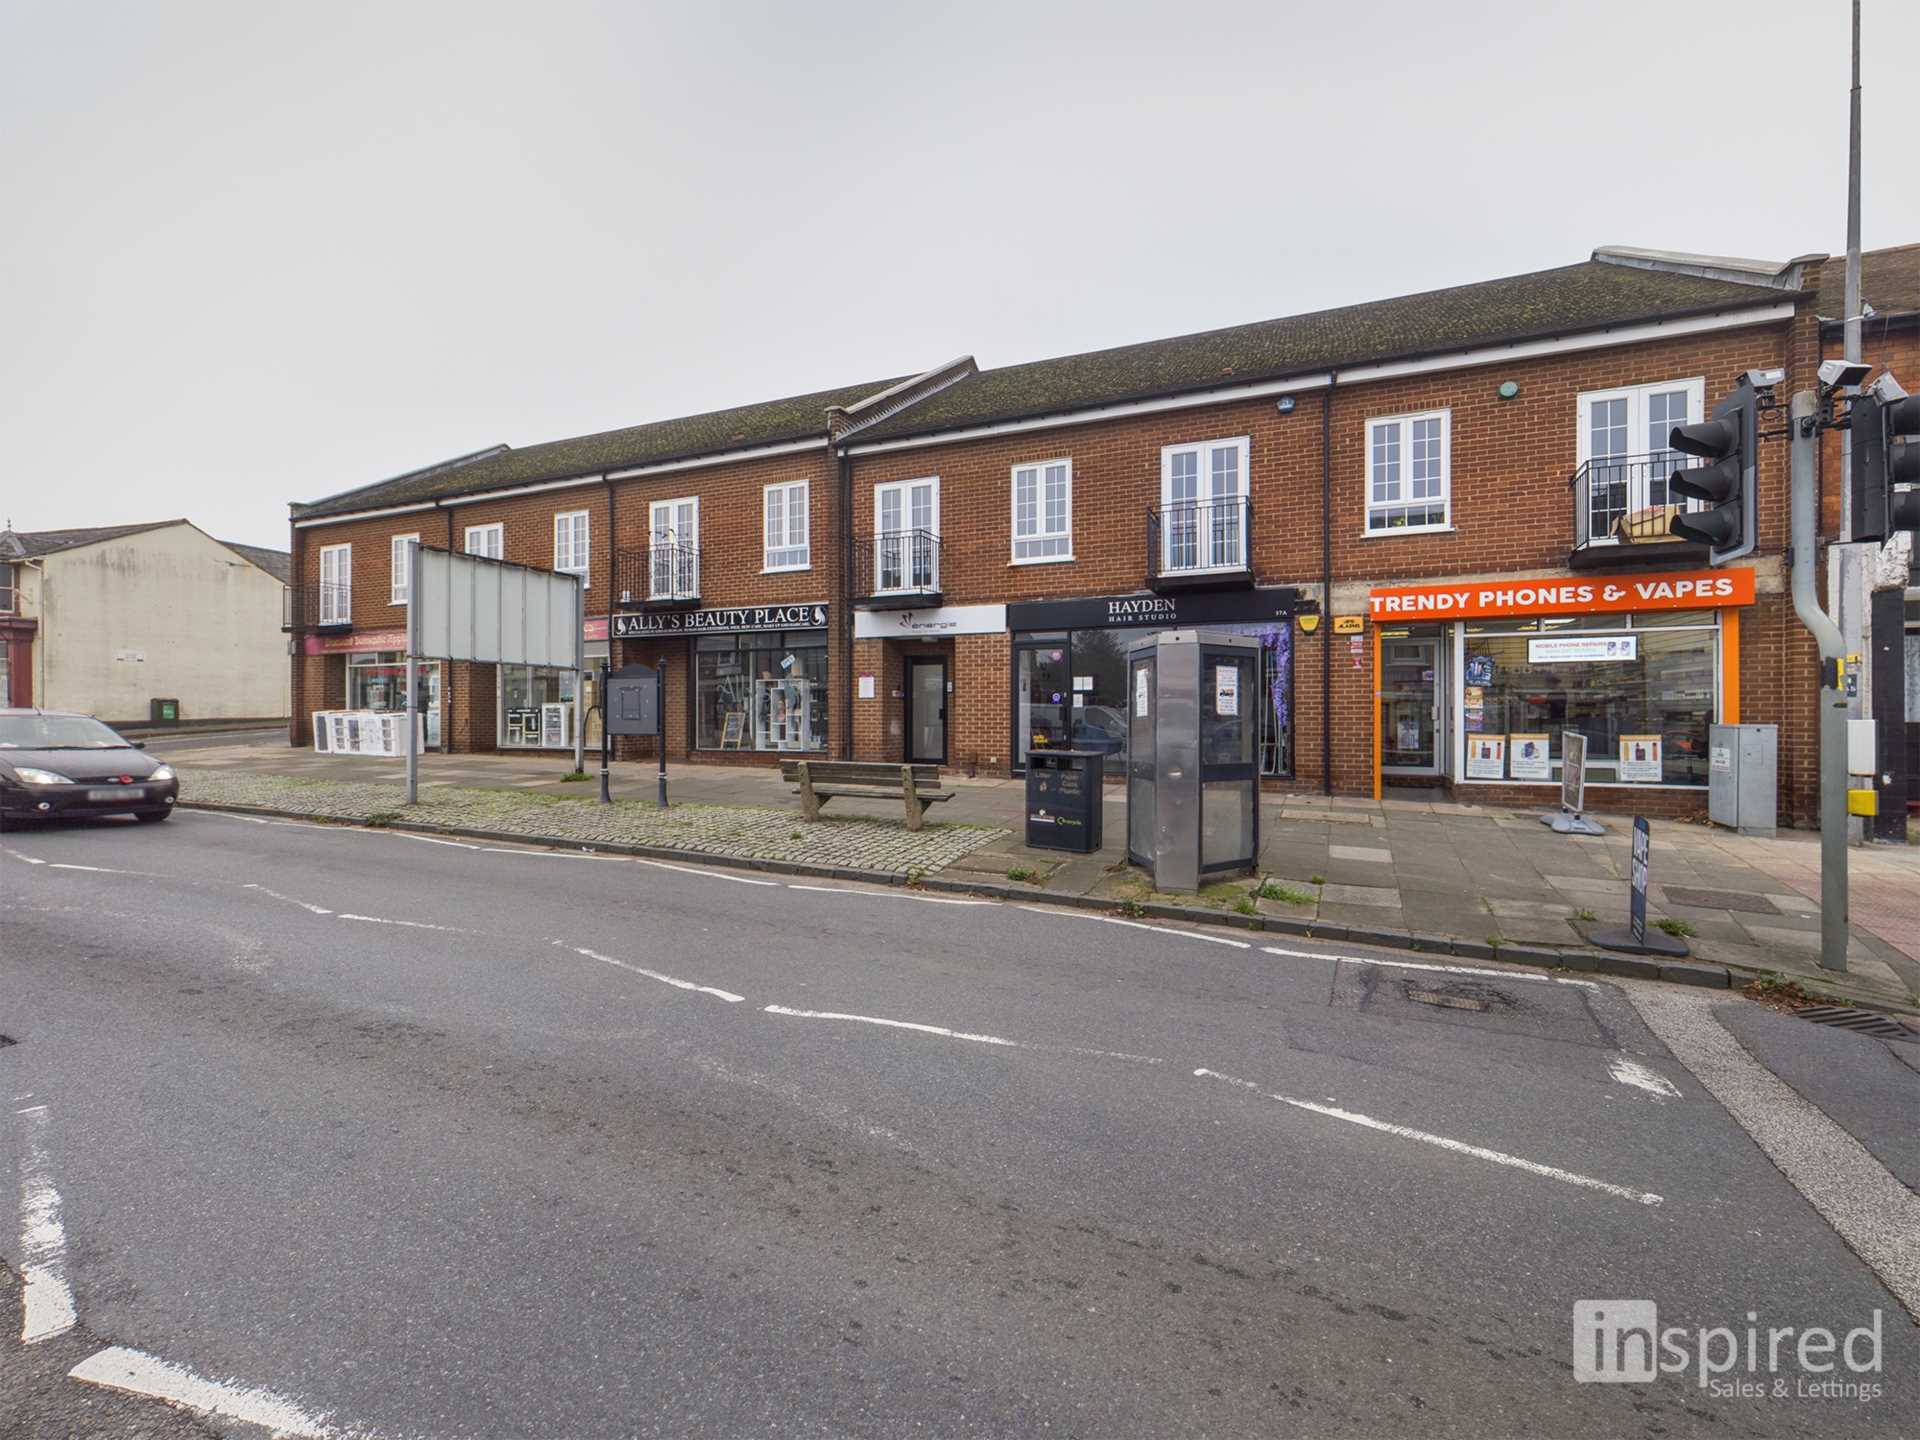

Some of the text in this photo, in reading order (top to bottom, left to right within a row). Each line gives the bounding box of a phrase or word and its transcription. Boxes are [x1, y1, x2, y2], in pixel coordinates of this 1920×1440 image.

[1370, 578, 1734, 613] TRENDY PHONES & VAPES
[1108, 599, 1176, 614] HAYDEN
[628, 614, 680, 630] ALLY'S
[685, 610, 749, 628] BEAUTY
[754, 606, 810, 624] PLACE
[1108, 613, 1177, 623] HAIR STUDIO
